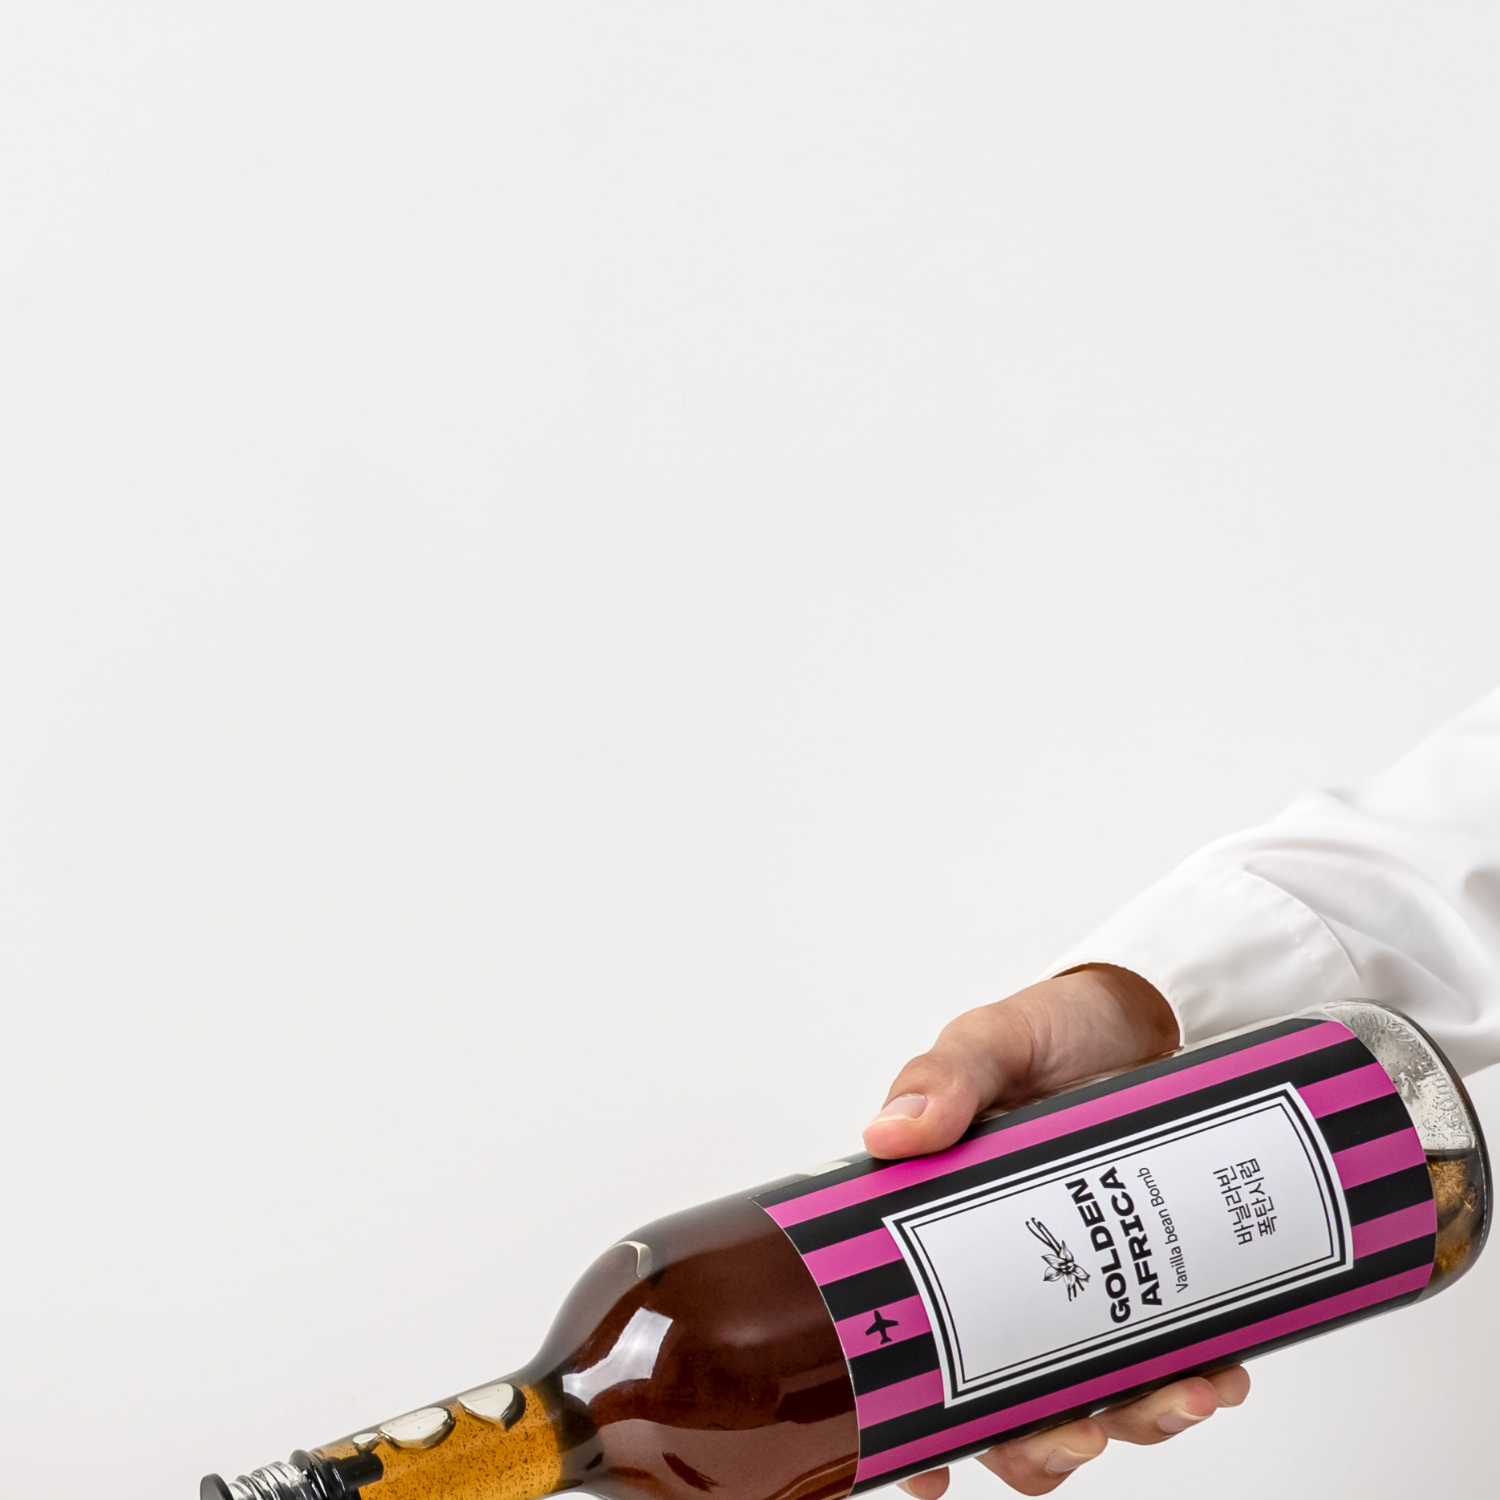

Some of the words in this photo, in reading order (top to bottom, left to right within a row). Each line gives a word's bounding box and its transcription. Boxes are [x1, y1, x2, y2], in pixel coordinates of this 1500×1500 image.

[1137, 1167, 1165, 1206] Bomb
[1158, 1208, 1179, 1244] bean
[1212, 1165, 1254, 1245] 바닐라빈
[1235, 1157, 1277, 1237] 폭탄시럽
[1065, 1178, 1132, 1324] GOLDEN
[1098, 1165, 1164, 1306] AFRICA
[1168, 1245, 1189, 1294] Vanilla
